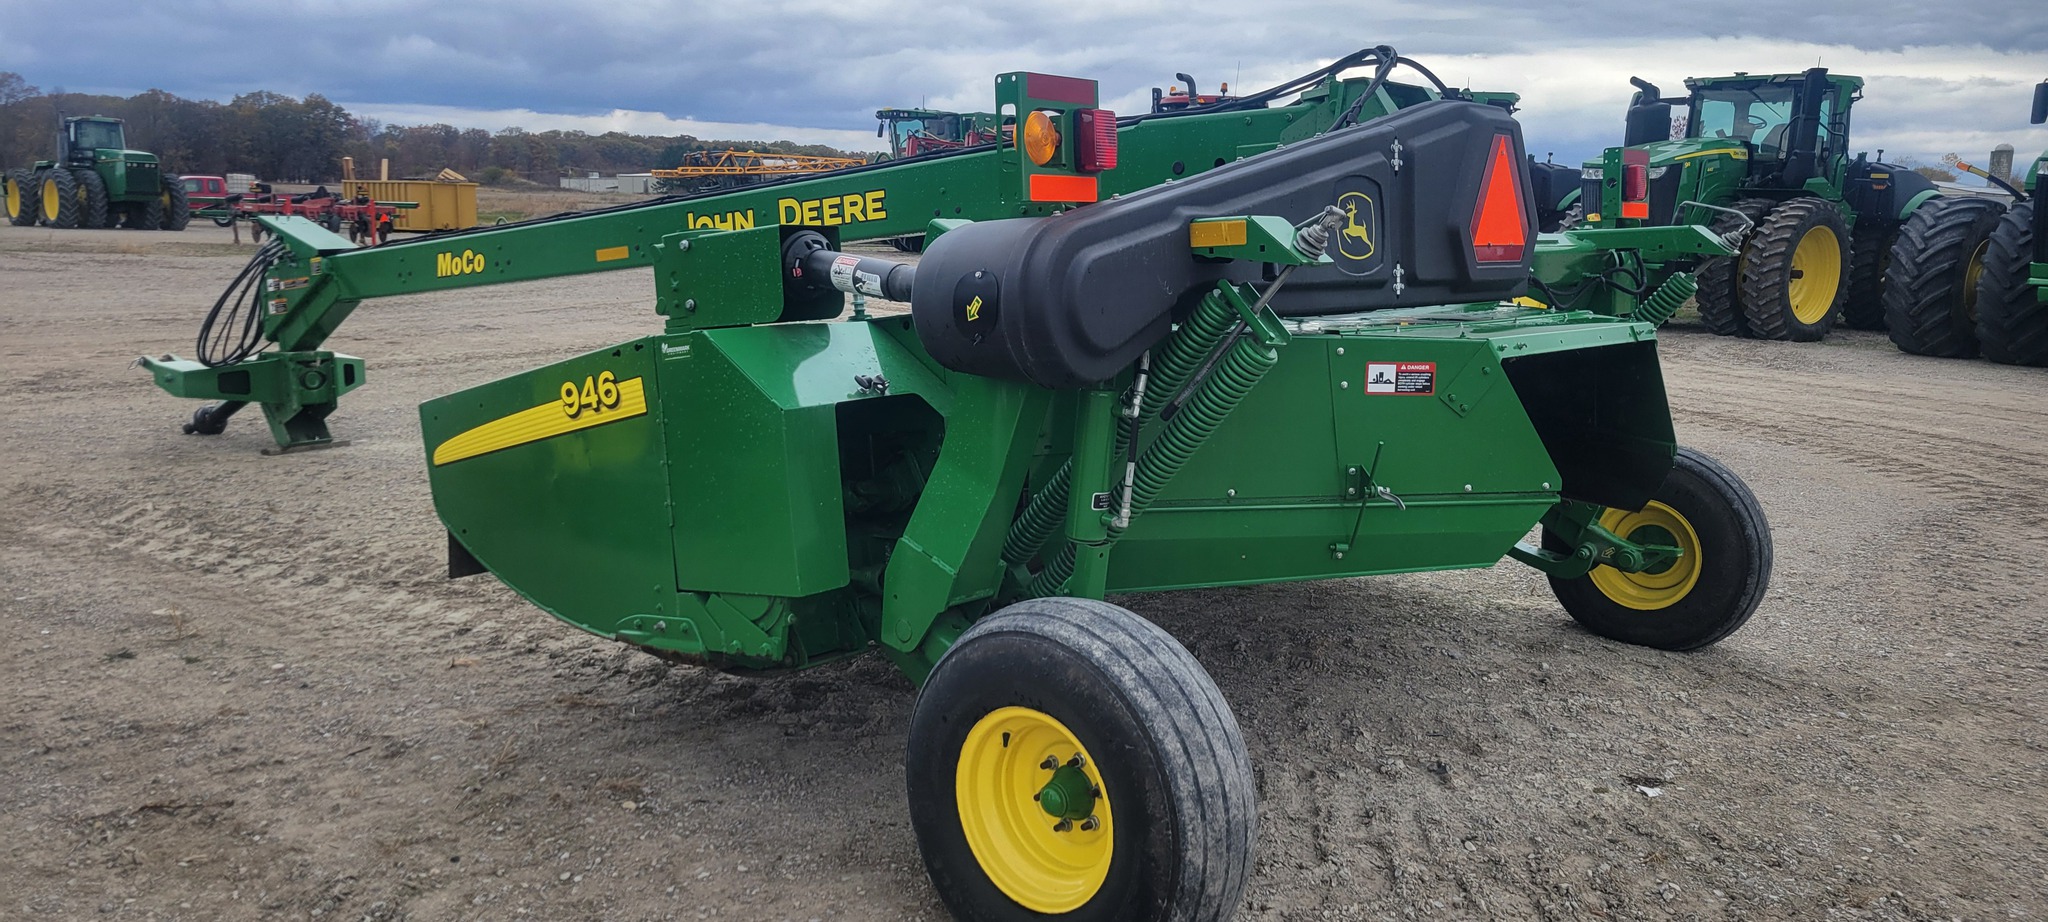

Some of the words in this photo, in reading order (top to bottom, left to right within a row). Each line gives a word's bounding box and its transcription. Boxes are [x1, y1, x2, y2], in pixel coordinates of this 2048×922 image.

[778, 189, 887, 226] DEERE
[437, 249, 485, 277] MoCo
[560, 371, 619, 419] 946
